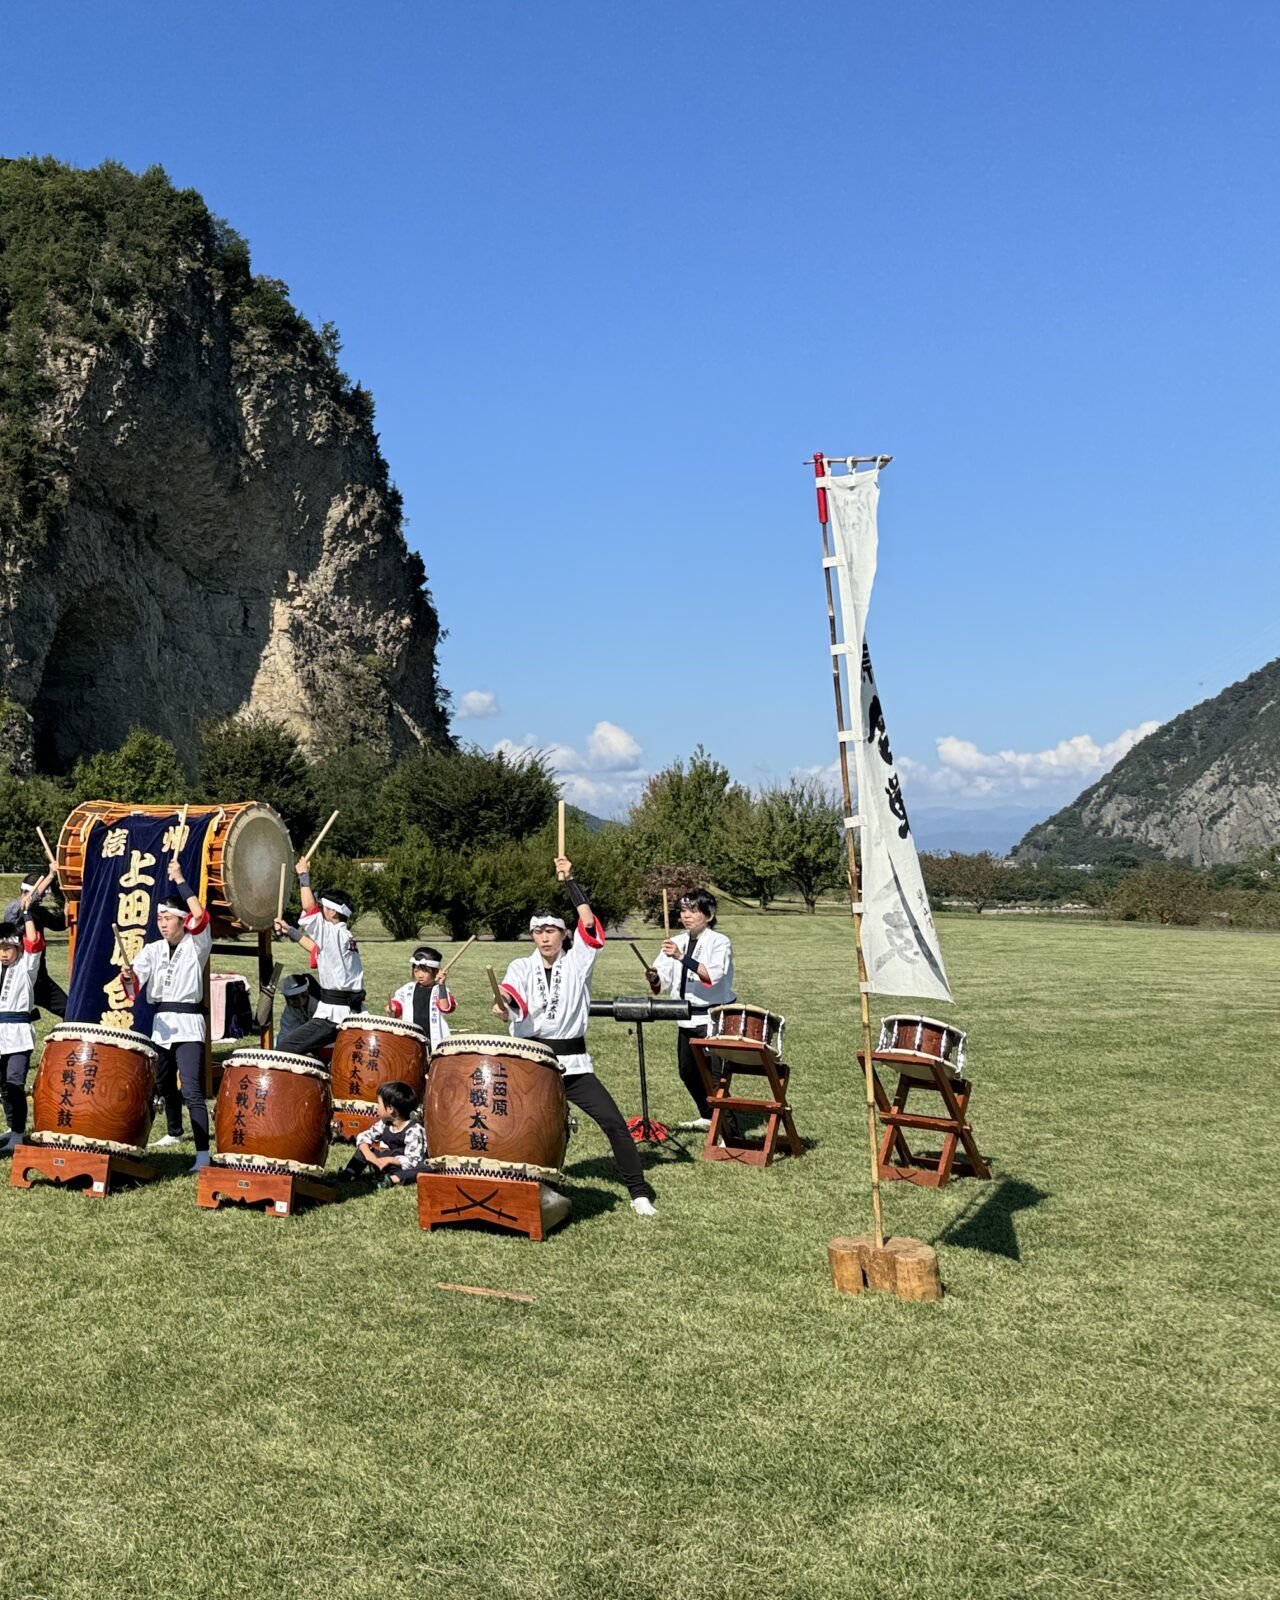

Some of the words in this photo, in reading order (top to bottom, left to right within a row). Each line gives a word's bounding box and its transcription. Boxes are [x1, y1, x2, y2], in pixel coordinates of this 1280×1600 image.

[56, 1050, 79, 1129] 合戦太鼓
[231, 1074, 253, 1147] 合戦太鼓
[468, 1066, 490, 1152] 合戦太鼓
[491, 1061, 509, 1117] 上田原
